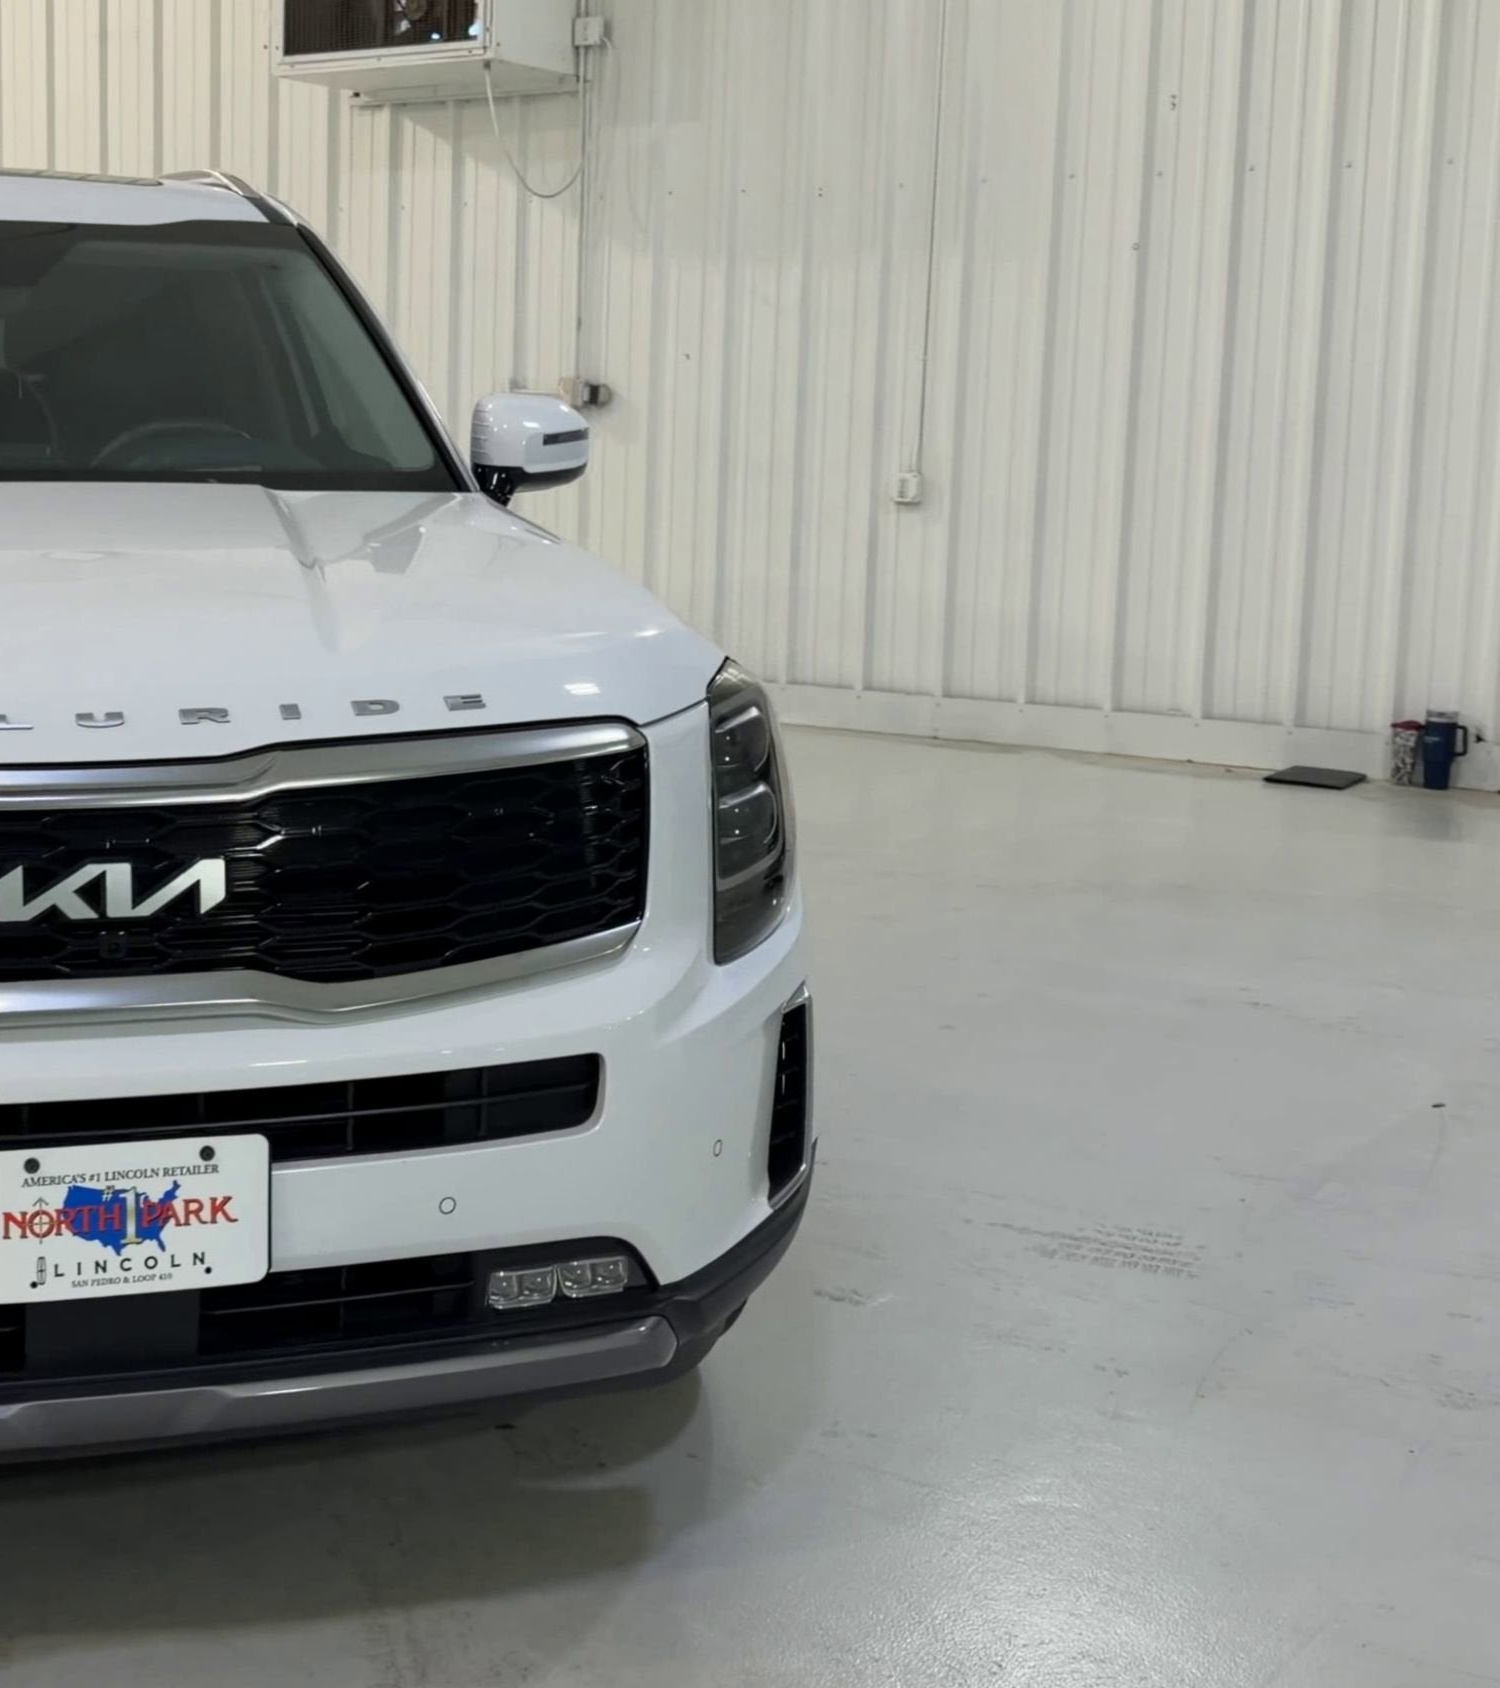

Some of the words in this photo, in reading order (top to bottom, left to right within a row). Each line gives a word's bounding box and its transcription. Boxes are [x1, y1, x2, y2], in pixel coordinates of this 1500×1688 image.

[21, 1173, 87, 1188] AMERICA'S
[88, 1172, 101, 1183] #1
[104, 1167, 162, 1182] LINCOLN
[162, 1163, 220, 1178] RETAILER
[2, 1202, 121, 1240] NORTH
[142, 1196, 239, 1228] PARK
[54, 1252, 206, 1278] LINCOLN
[71, 1279, 89, 1288] SAN
[122, 1276, 131, 1284] &
